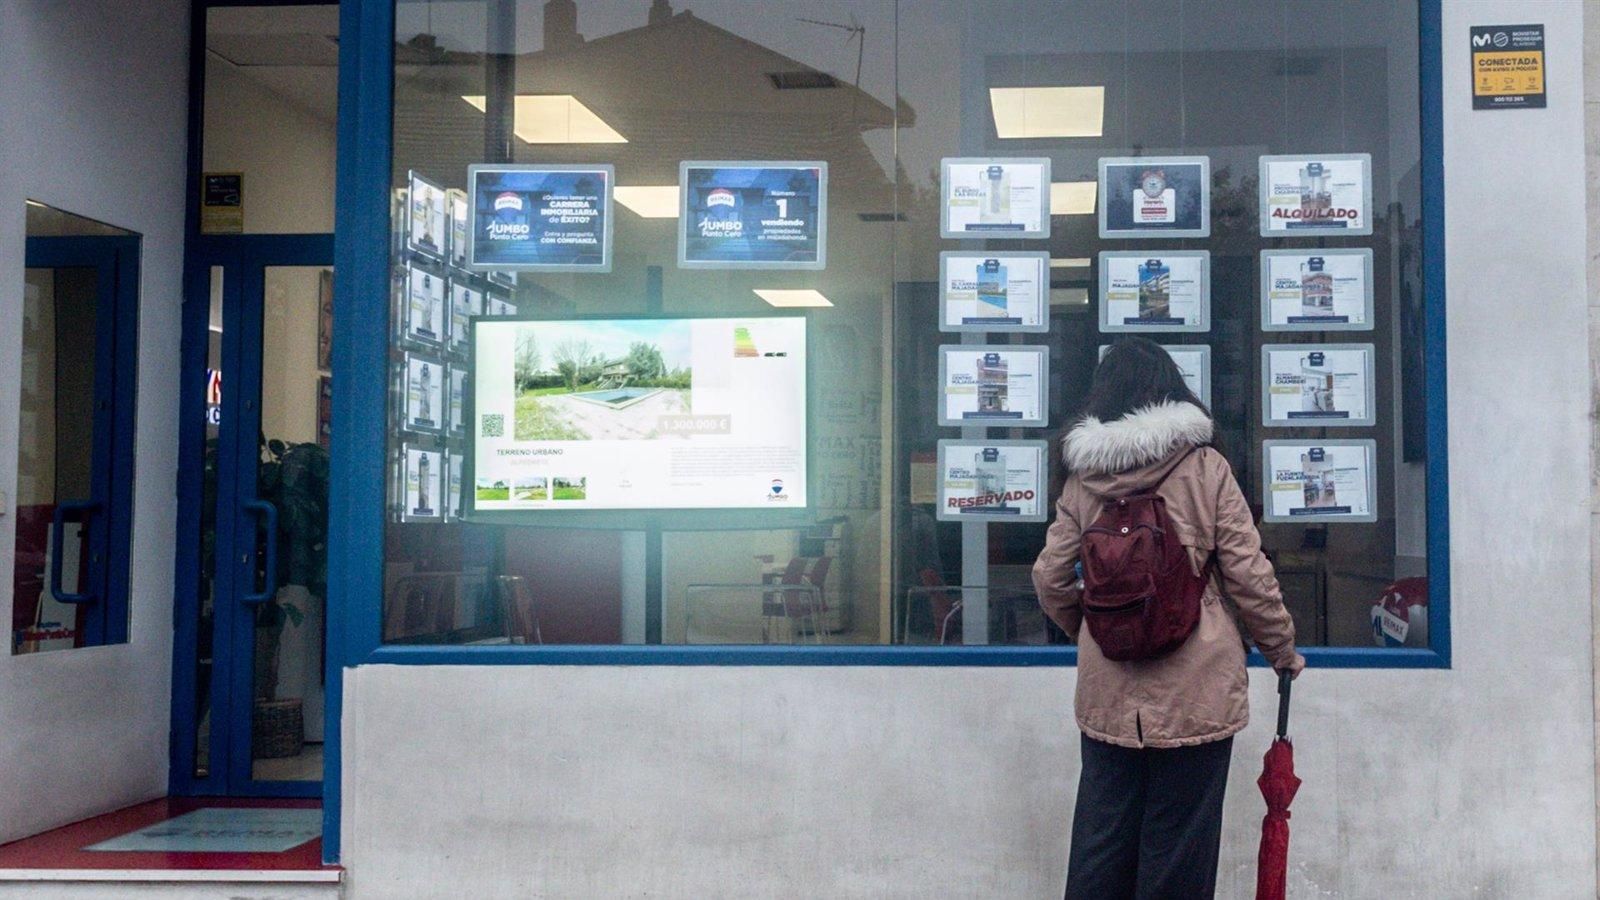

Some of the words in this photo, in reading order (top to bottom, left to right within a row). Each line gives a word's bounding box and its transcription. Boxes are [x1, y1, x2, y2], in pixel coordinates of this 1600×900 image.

[1478, 58, 1538, 66] CONECTADA
[540, 208, 598, 216] INMOBILIARIA
[775, 198, 788, 218] 1
[1272, 207, 1358, 220] ALQUILADO
[560, 215, 590, 224] ÉXITO?
[698, 216, 743, 231] JUMBO
[761, 219, 805, 227] vendiendo
[486, 220, 530, 234] JUMBO
[663, 419, 717, 430] 1.300.000
[719, 419, 727, 430] €
[531, 448, 564, 456] URBANO
[948, 489, 1035, 508] RESERVADO
